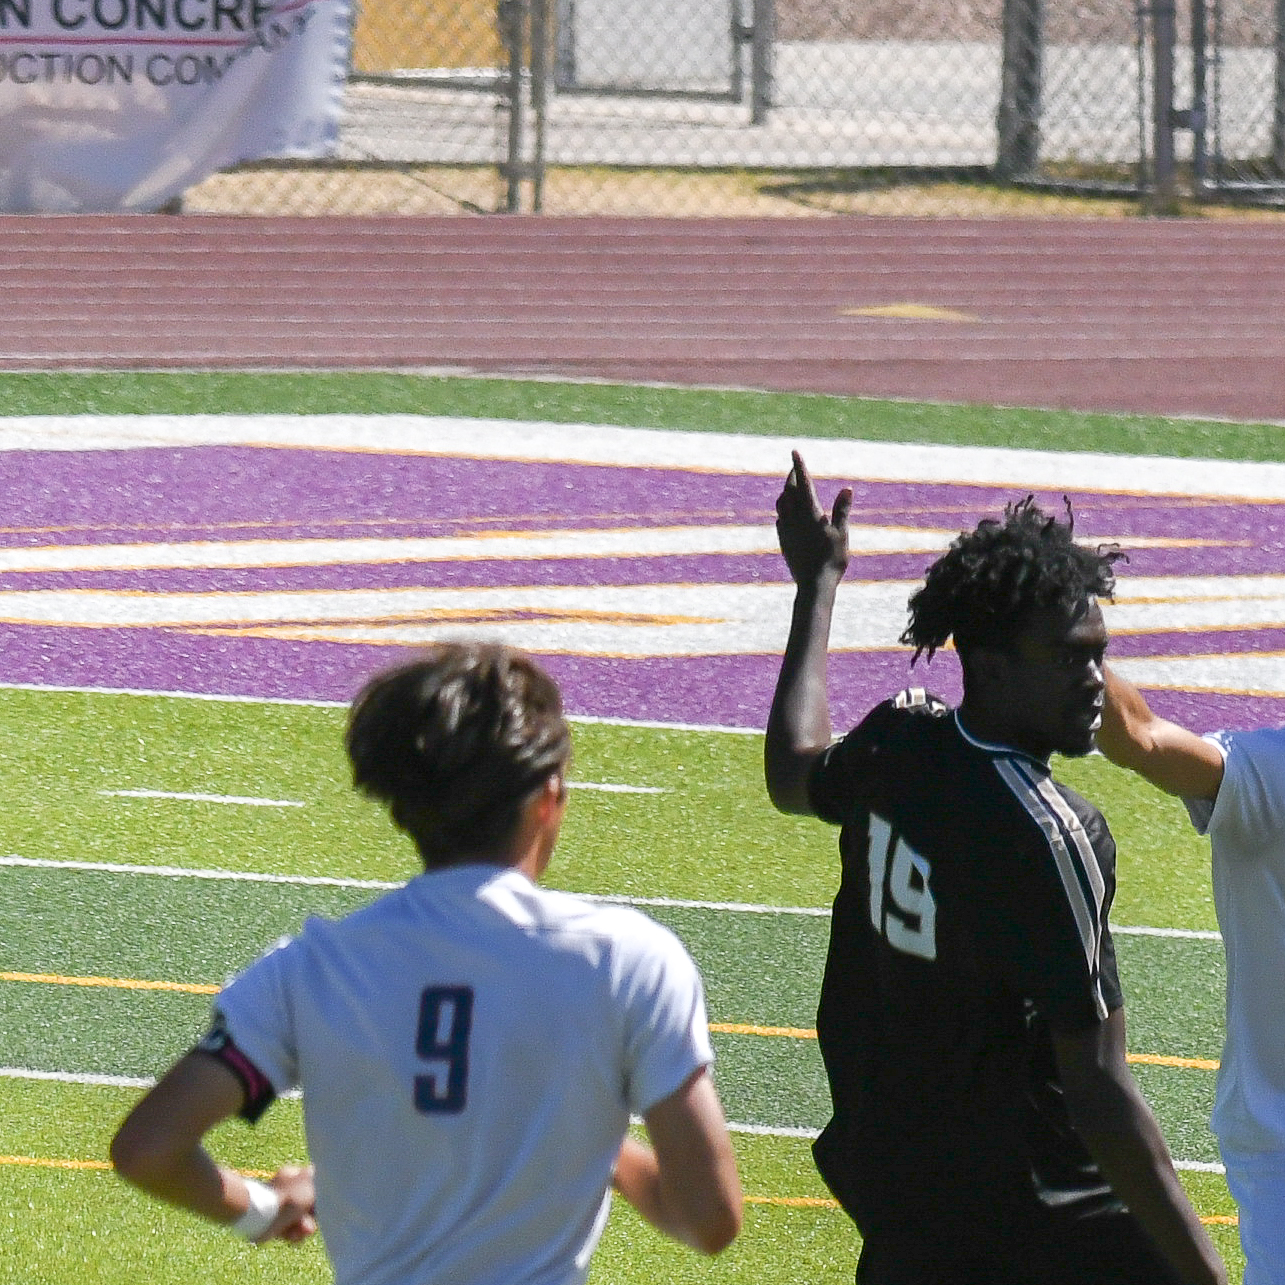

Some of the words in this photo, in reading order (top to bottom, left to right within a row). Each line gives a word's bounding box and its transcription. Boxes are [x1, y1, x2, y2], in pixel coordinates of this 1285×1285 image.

[0, 52, 133, 86] CTION
[868, 812, 937, 962] 19
[413, 983, 475, 1116] 9
